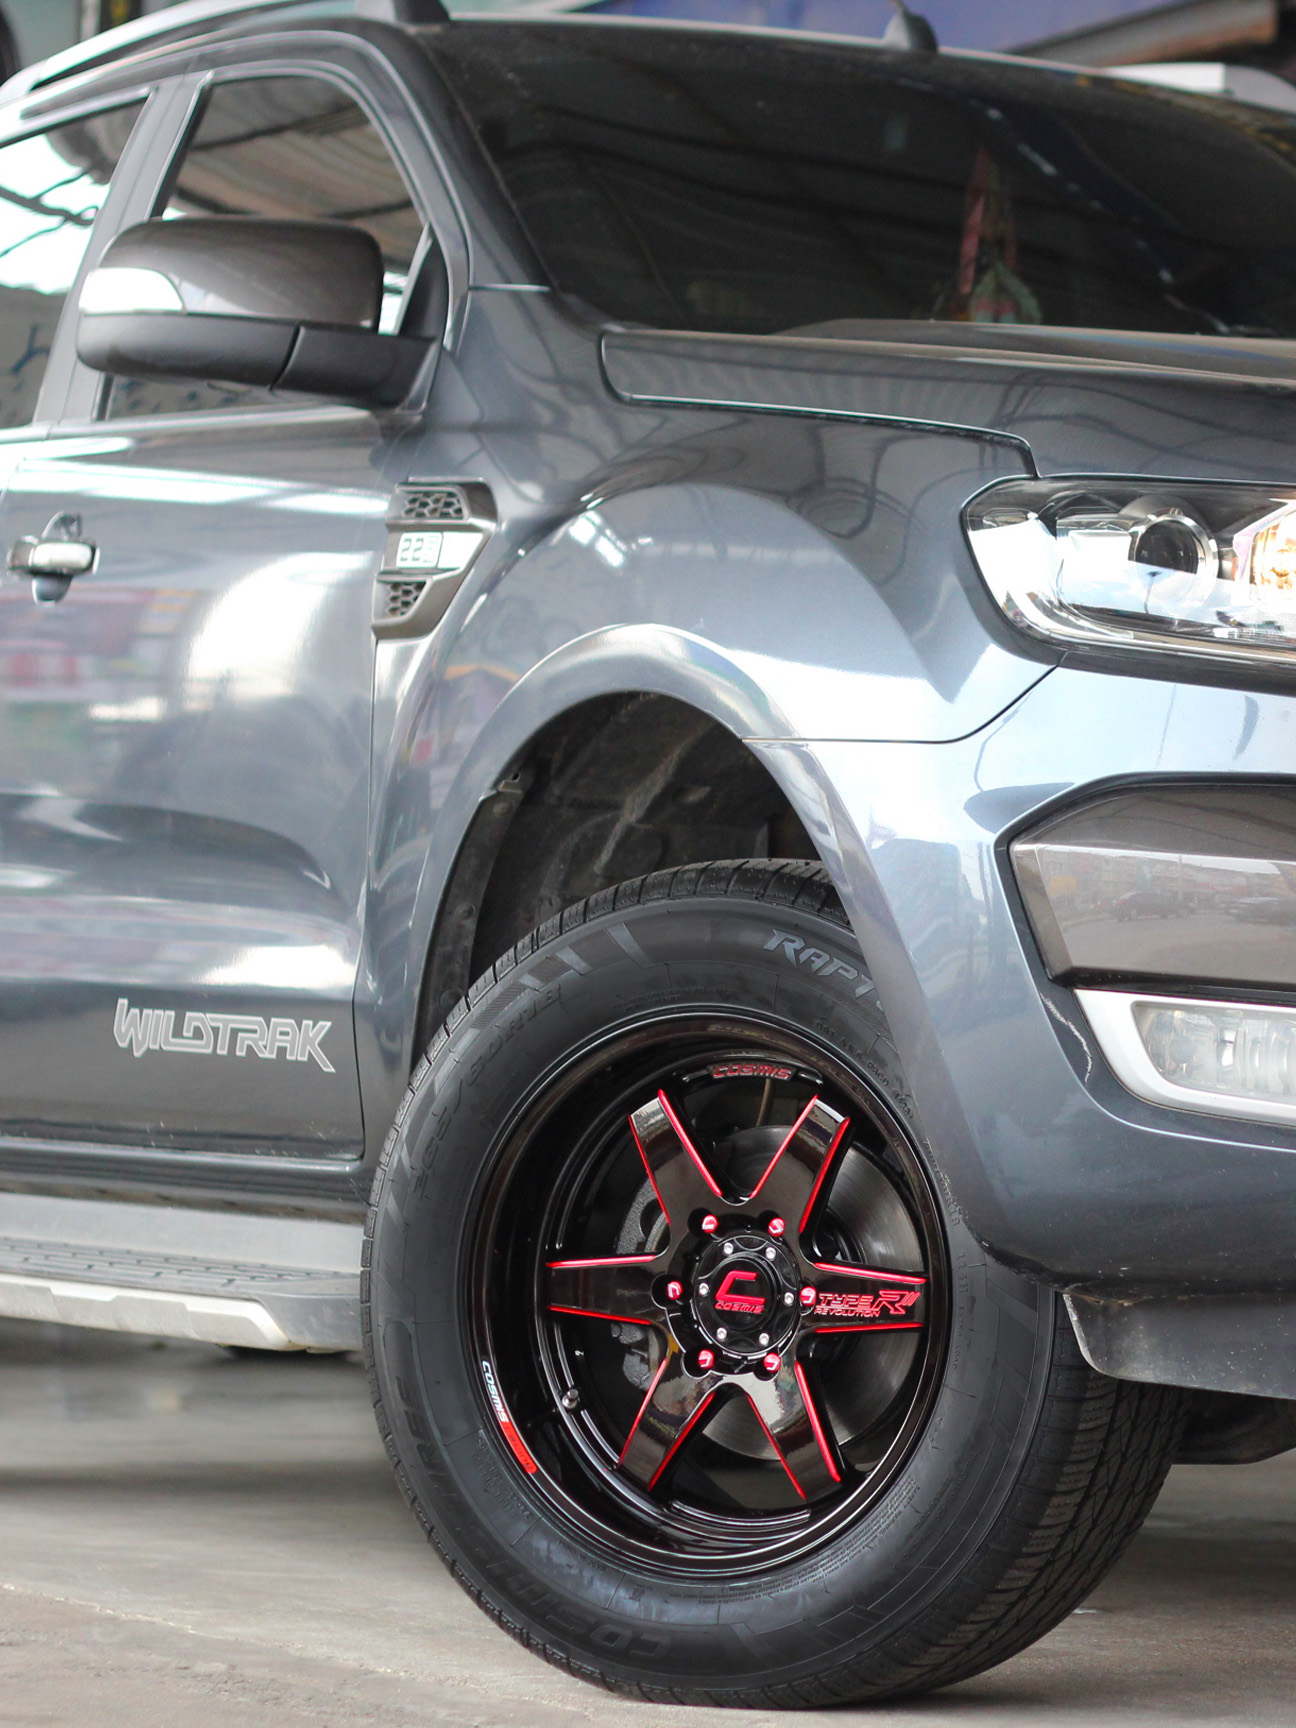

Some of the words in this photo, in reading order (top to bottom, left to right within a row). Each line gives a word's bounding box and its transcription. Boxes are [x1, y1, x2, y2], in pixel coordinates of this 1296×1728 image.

[113, 998, 336, 1073] WILDTRAK
[713, 1064, 792, 1080] COSMIS
[714, 1301, 765, 1314] COSMIS
[814, 1308, 881, 1318] REVOLUTION
[482, 1360, 510, 1423] COSMIS
